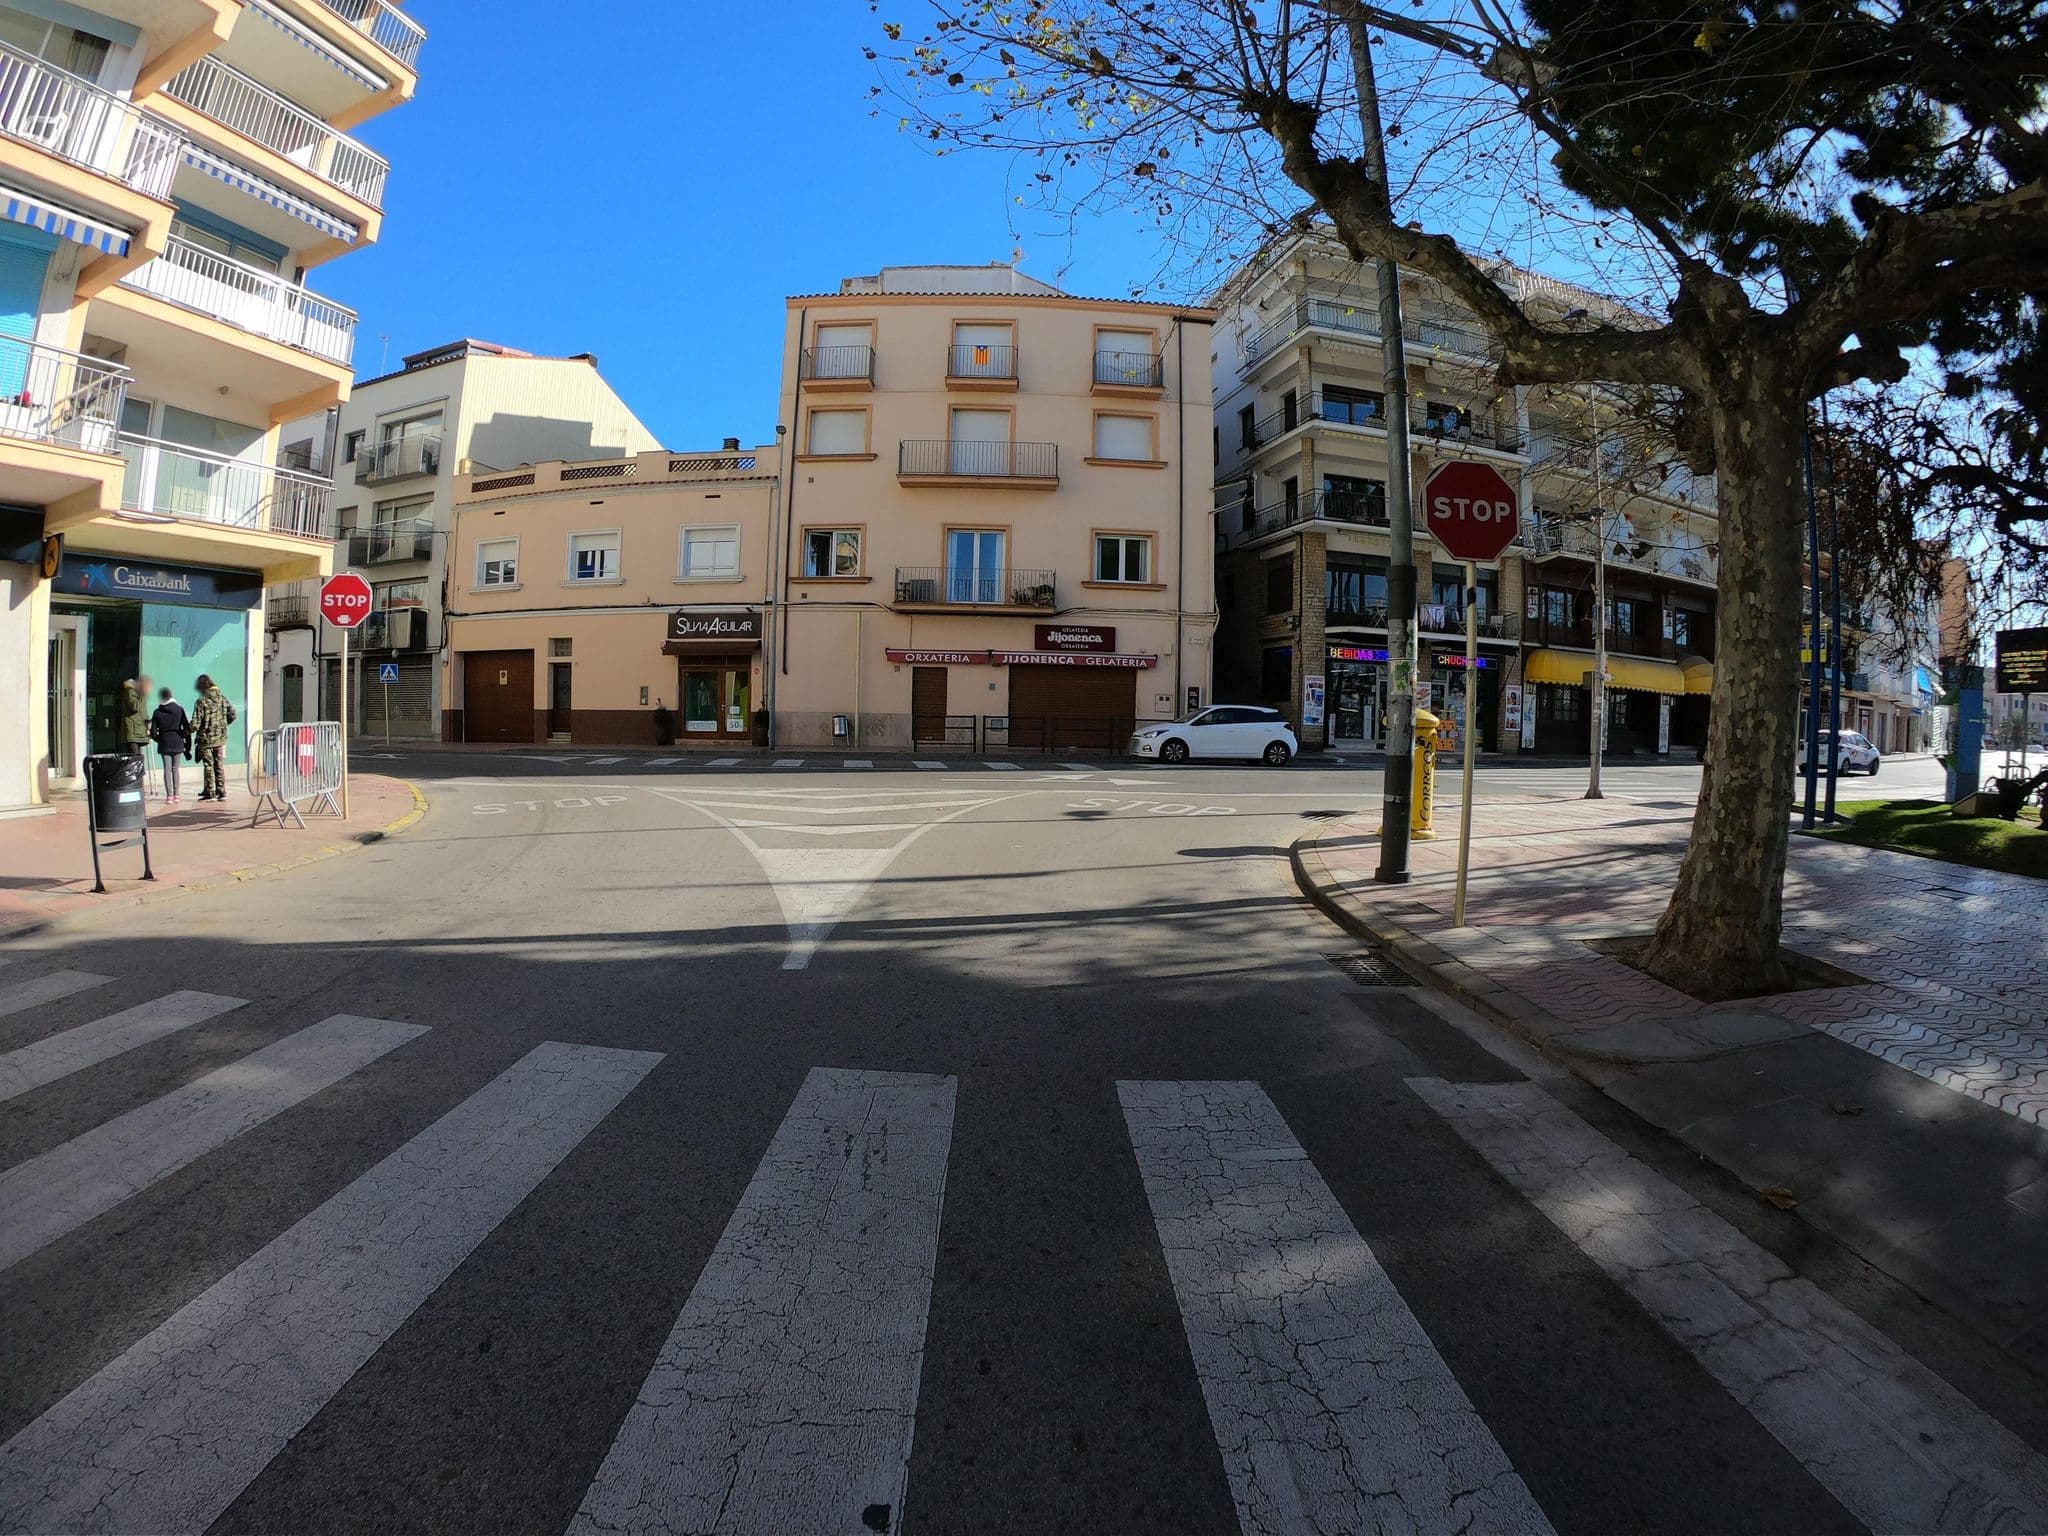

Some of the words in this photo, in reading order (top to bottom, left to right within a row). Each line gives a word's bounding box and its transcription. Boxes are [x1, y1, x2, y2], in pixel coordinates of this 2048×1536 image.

[1433, 496, 1511, 523] STOP
[323, 593, 368, 607] STOP
[1047, 631, 1103, 643] Jijonenca
[905, 653, 970, 663] ORXATERIA
[1330, 648, 1373, 660] BEBIDAS
[1002, 655, 1075, 665] JIJONENCA
[1085, 657, 1147, 668] GELATERIA
[1420, 741, 1433, 822] CORREOS
[472, 795, 628, 815] STOP
[1066, 798, 1237, 816] STOP
